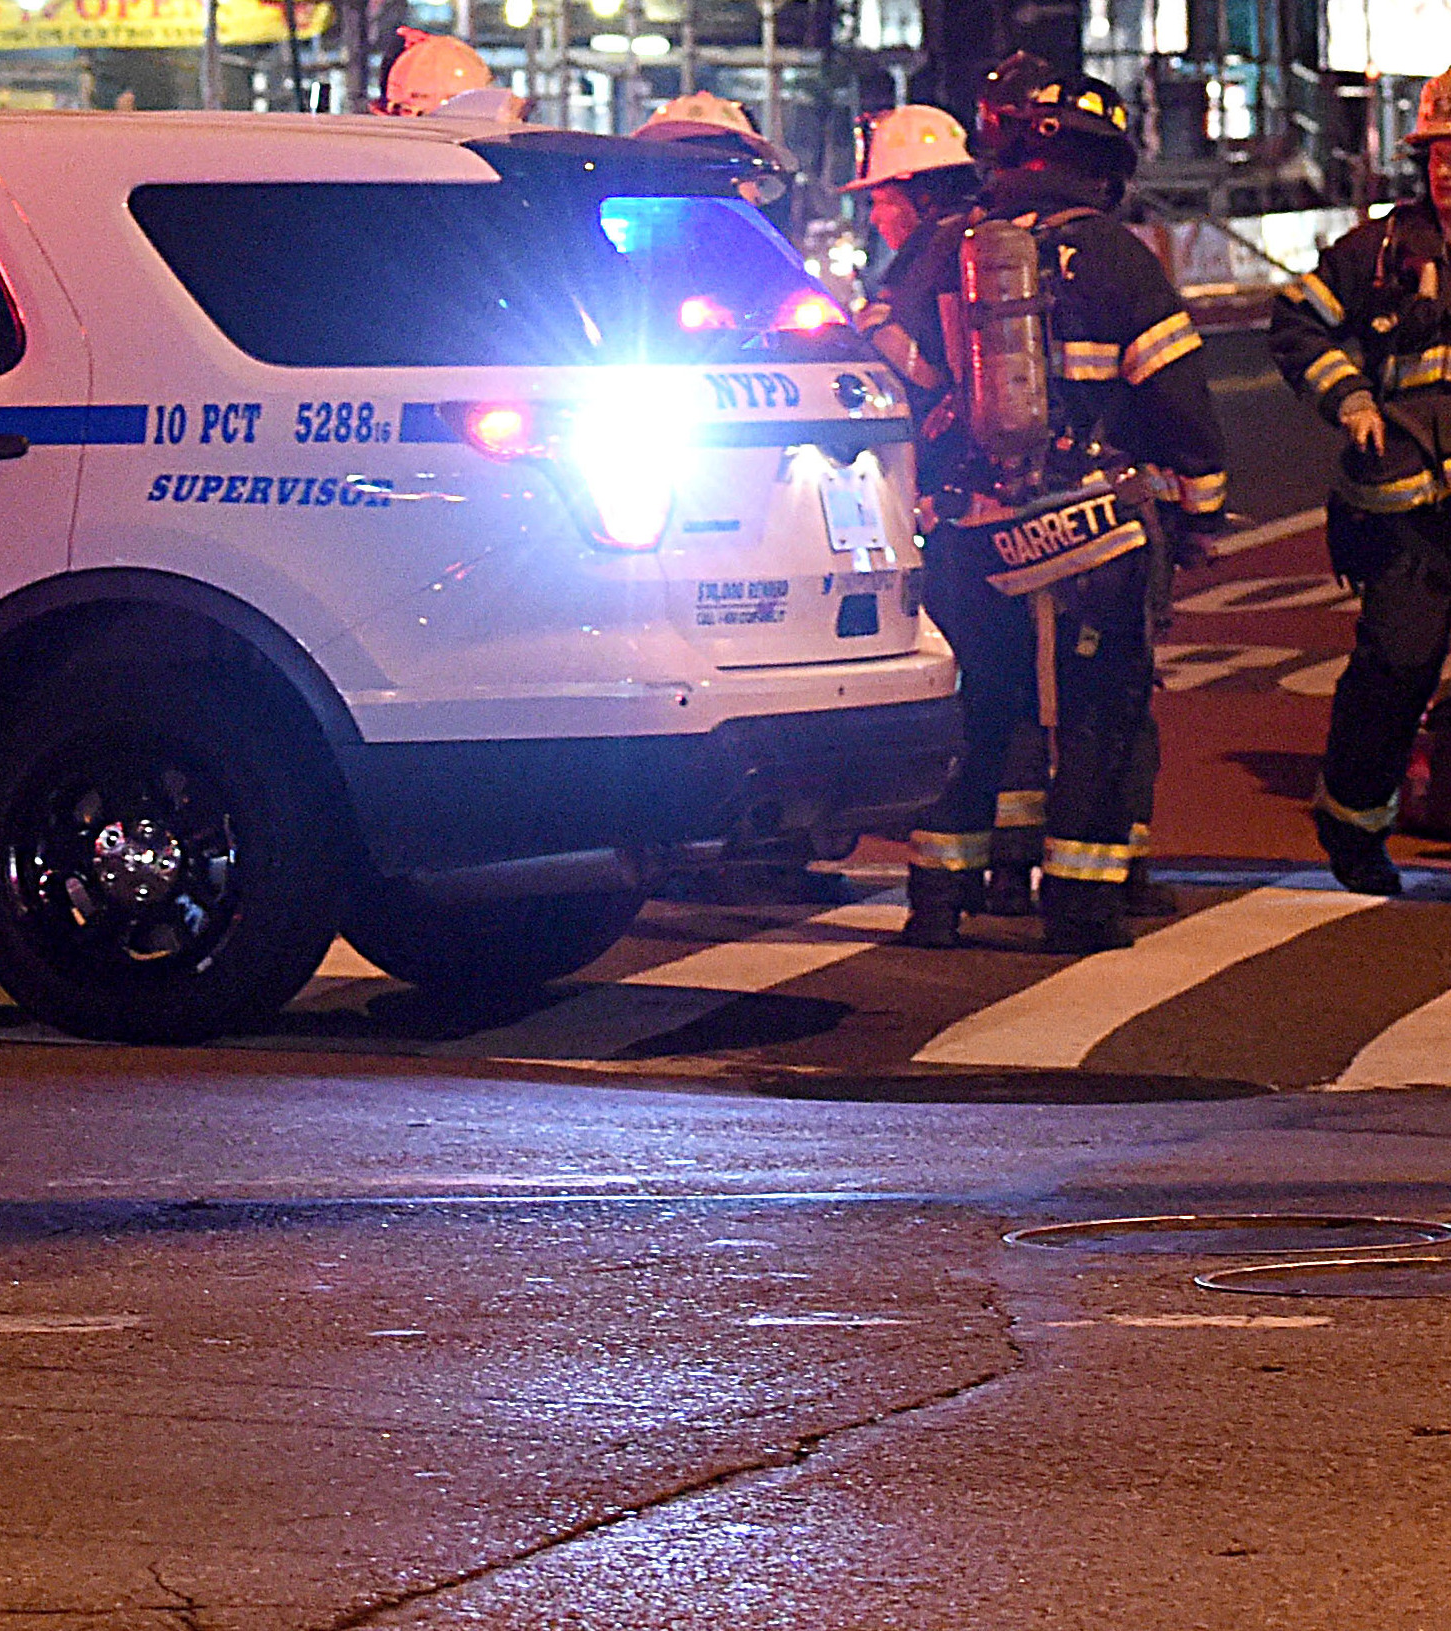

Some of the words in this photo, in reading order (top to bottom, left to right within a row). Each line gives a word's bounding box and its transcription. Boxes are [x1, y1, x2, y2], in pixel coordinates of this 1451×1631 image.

[706, 372, 800, 410] NYPD
[153, 403, 188, 445] 10
[200, 402, 262, 445] PCT
[993, 493, 1118, 566] BARRETT
